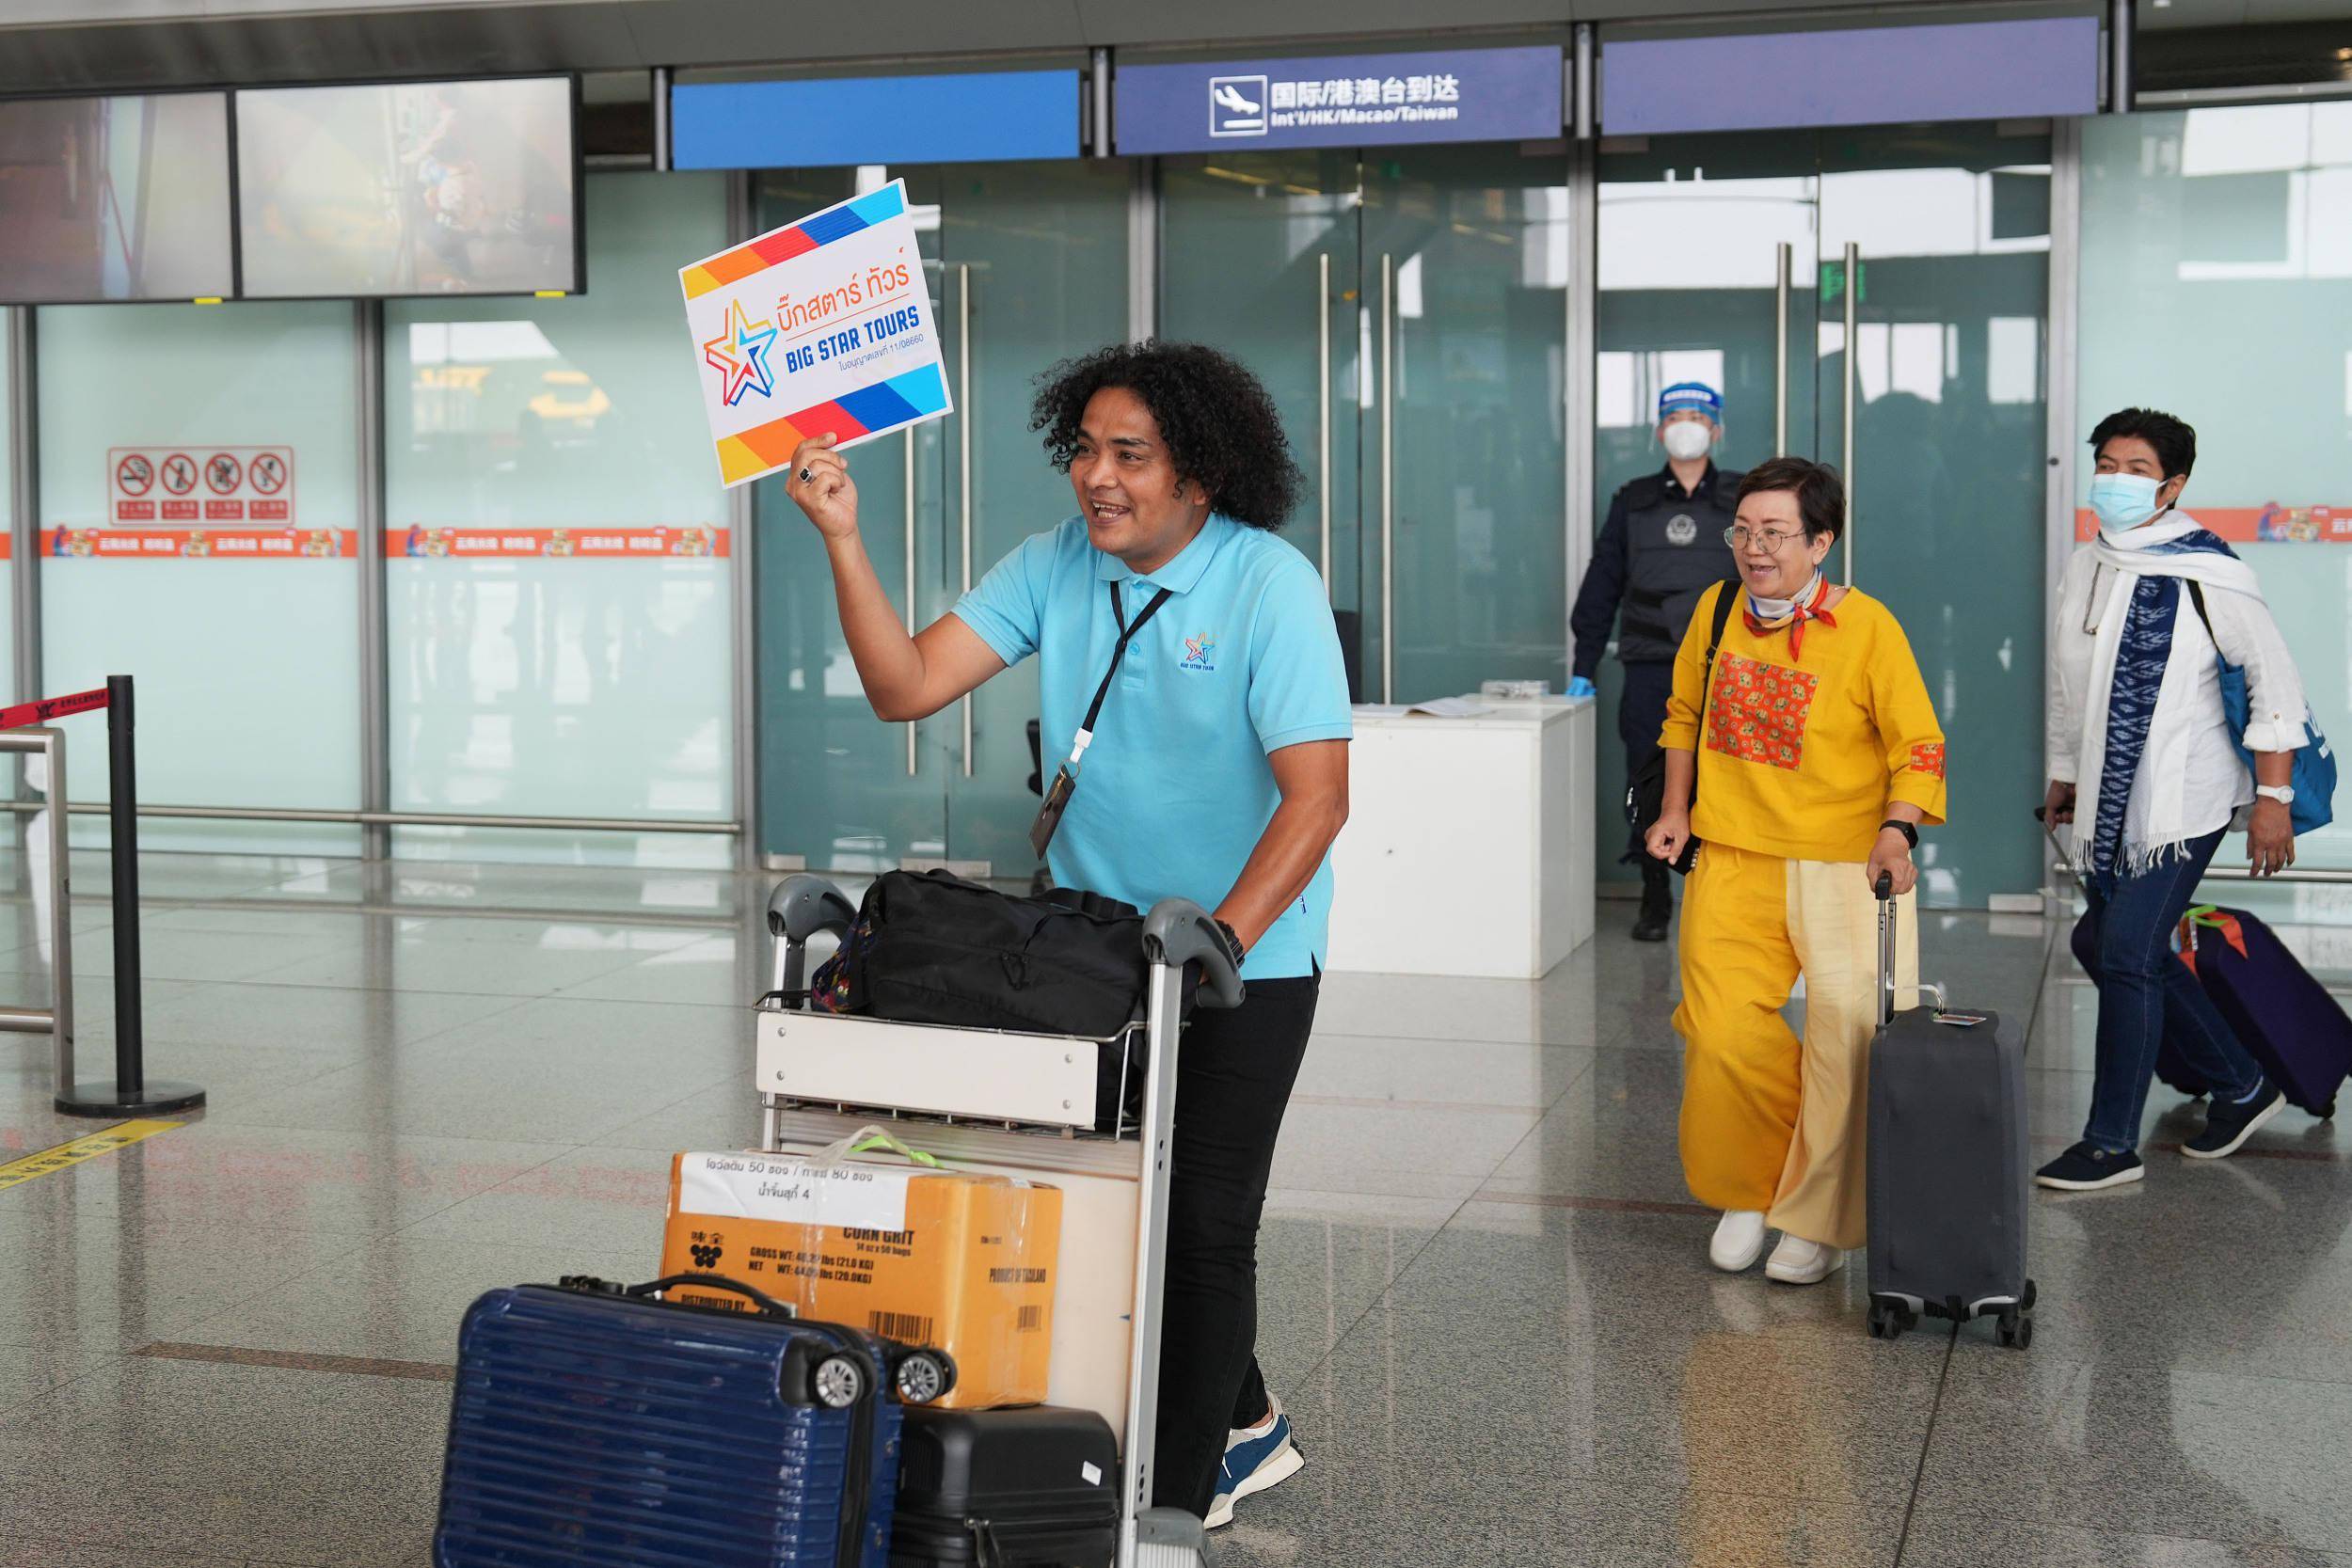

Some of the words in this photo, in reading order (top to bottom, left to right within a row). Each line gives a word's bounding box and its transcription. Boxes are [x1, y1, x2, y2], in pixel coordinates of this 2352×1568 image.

[1271, 73, 1459, 109] 国际/港澳台到达
[776, 273, 863, 332] บิ๊กสตาร์
[866, 246, 910, 299] ทัวร์
[786, 344, 814, 373] BIG
[818, 327, 861, 362] STAR
[864, 305, 920, 343] TOURS
[749, 1162, 765, 1174] 50
[802, 1189, 810, 1200] 4
[843, 1227, 880, 1243] CORN
[882, 1229, 915, 1246] GRIT
[750, 1246, 777, 1259] GROSS
[821, 1256, 834, 1266] lbs
[748, 1260, 763, 1272] NET
[819, 1269, 834, 1280] lbs
[681, 1294, 734, 1310] DISTRIBUTED
